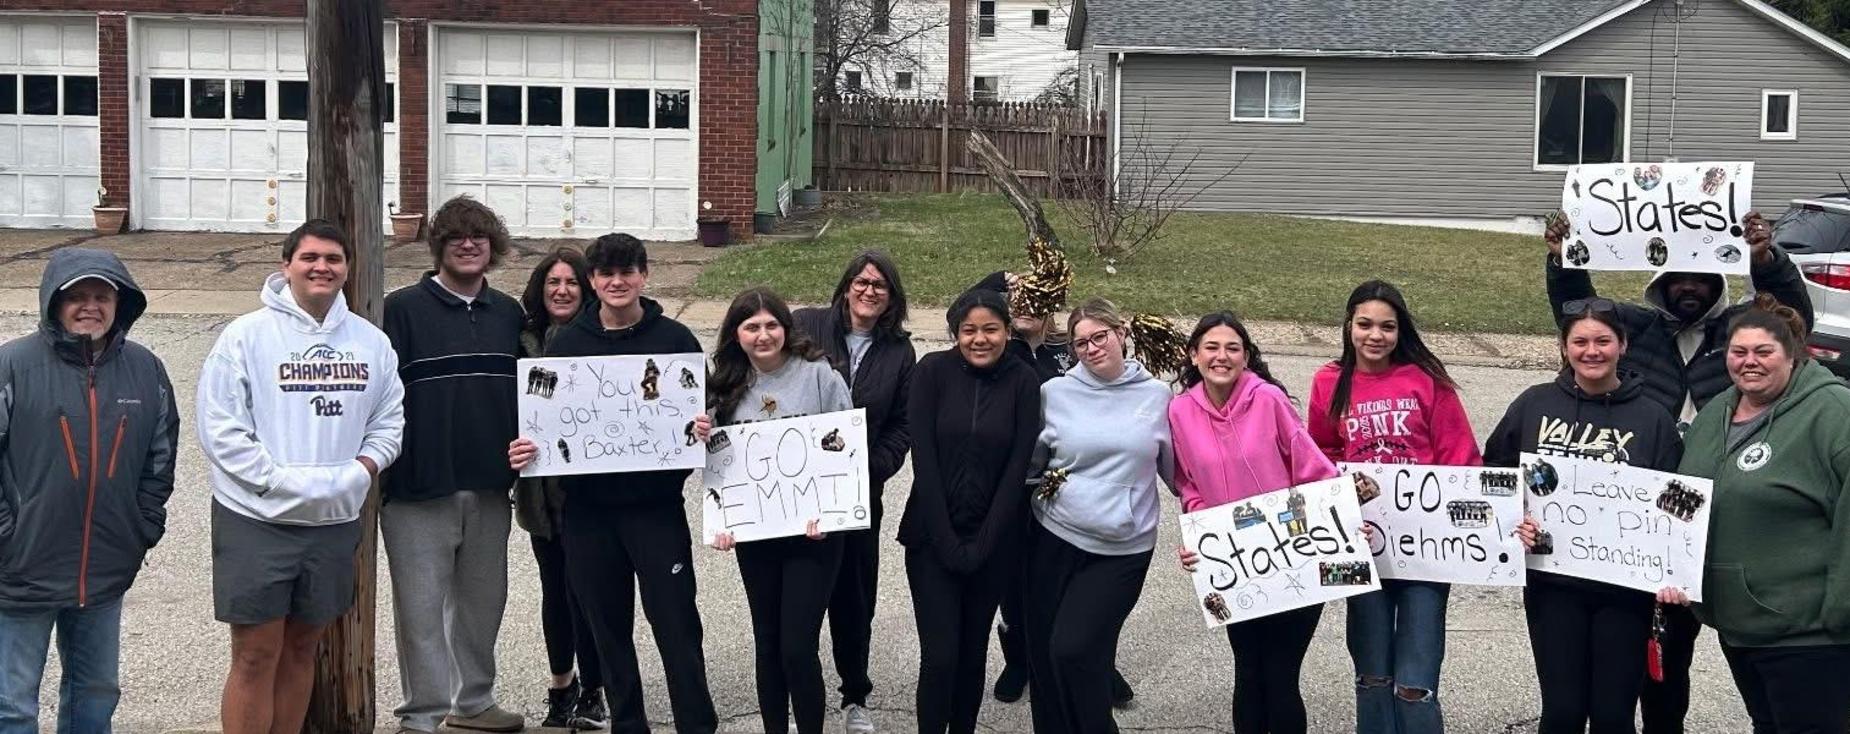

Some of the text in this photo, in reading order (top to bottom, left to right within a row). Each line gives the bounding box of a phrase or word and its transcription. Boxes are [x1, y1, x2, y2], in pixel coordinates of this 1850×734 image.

[1589, 178, 1743, 237] States!
[279, 362, 369, 380] CHAMPIONS
[290, 352, 301, 361] 20
[586, 363, 636, 398] You
[310, 395, 344, 416] Pitt
[560, 400, 601, 437] got
[1357, 399, 1392, 414] VIKINGS
[1538, 415, 1635, 453] VALLEY
[745, 427, 807, 481] GO
[721, 466, 867, 529] EMMI!
[1394, 469, 1442, 512] GO
[1573, 465, 1651, 502] Leave
[1543, 501, 1587, 525] no
[1198, 505, 1355, 591] States!
[1570, 536, 1674, 583] Standing!
